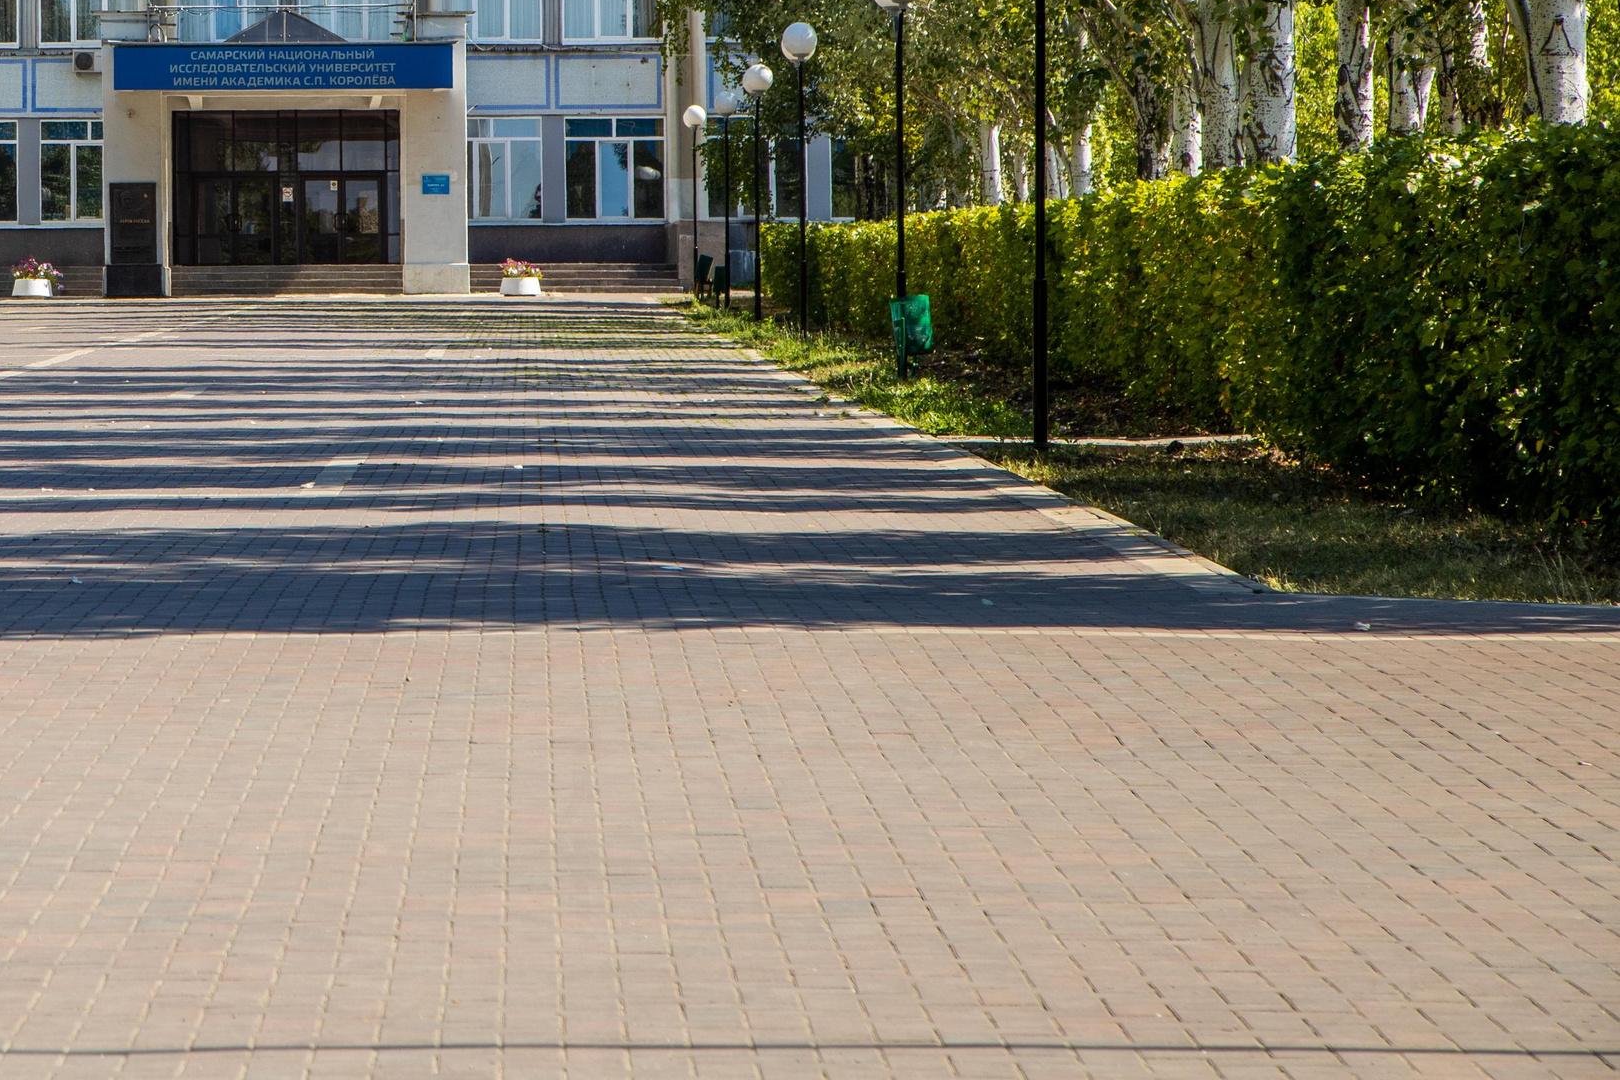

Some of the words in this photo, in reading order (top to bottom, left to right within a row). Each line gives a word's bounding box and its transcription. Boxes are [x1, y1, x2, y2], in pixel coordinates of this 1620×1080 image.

[190, 48, 265, 61] САМАРСКИЙ
[269, 48, 375, 61] НАЦИОНАЛЬНЫЙ
[169, 62, 306, 74] ИССЛЕДОВАТЕЛЬСКИЙ
[309, 62, 397, 73] УНИВЕРСИТЕТ
[173, 76, 218, 87] ИМЕНИ
[220, 76, 301, 88] АКАДЕМИКА
[303, 76, 326, 87] С.П.
[330, 74, 397, 87] КОРОЛЁВА
